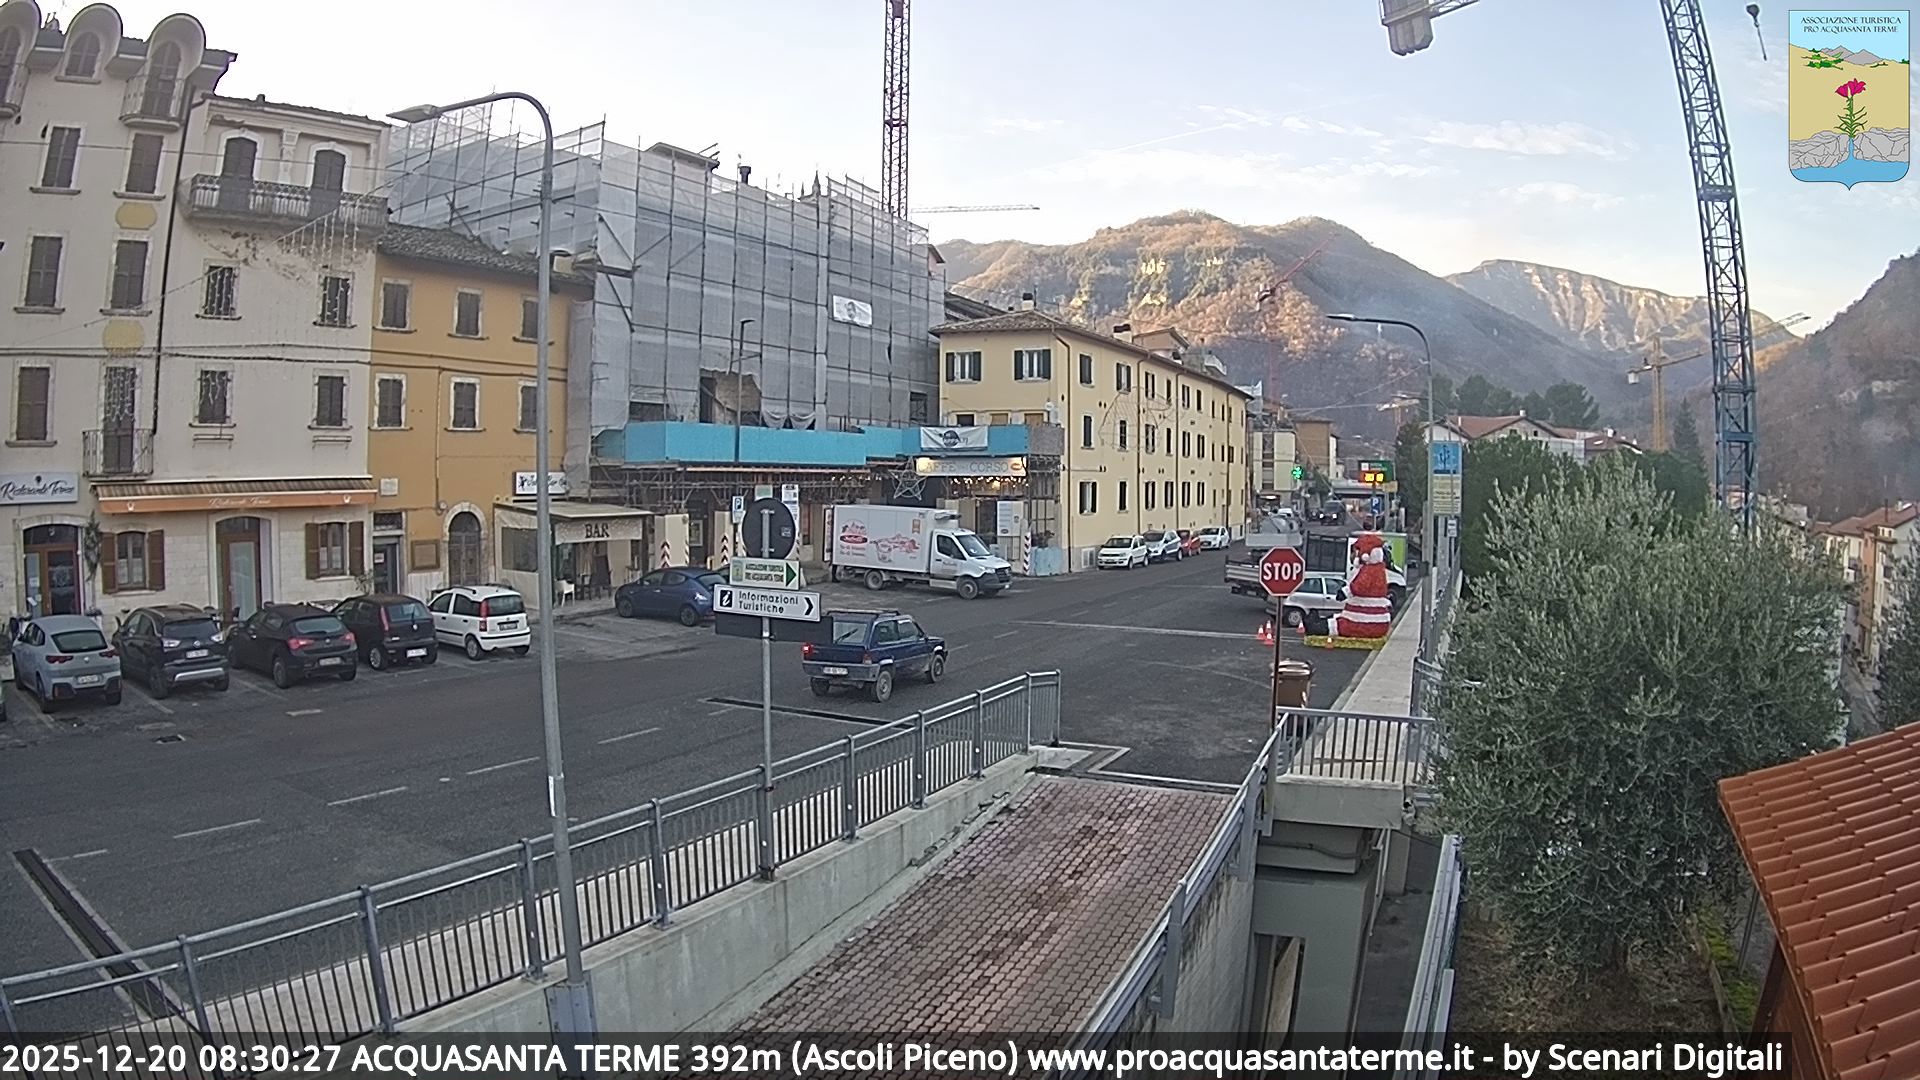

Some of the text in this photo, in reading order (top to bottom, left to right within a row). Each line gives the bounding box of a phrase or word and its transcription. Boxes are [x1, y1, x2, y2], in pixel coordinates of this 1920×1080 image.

[969, 461, 1009, 473] CORSO
[585, 523, 610, 538] BAR
[1263, 562, 1302, 581] STOP
[739, 590, 799, 605] Informazioni
[739, 600, 785, 614] Turistiche
